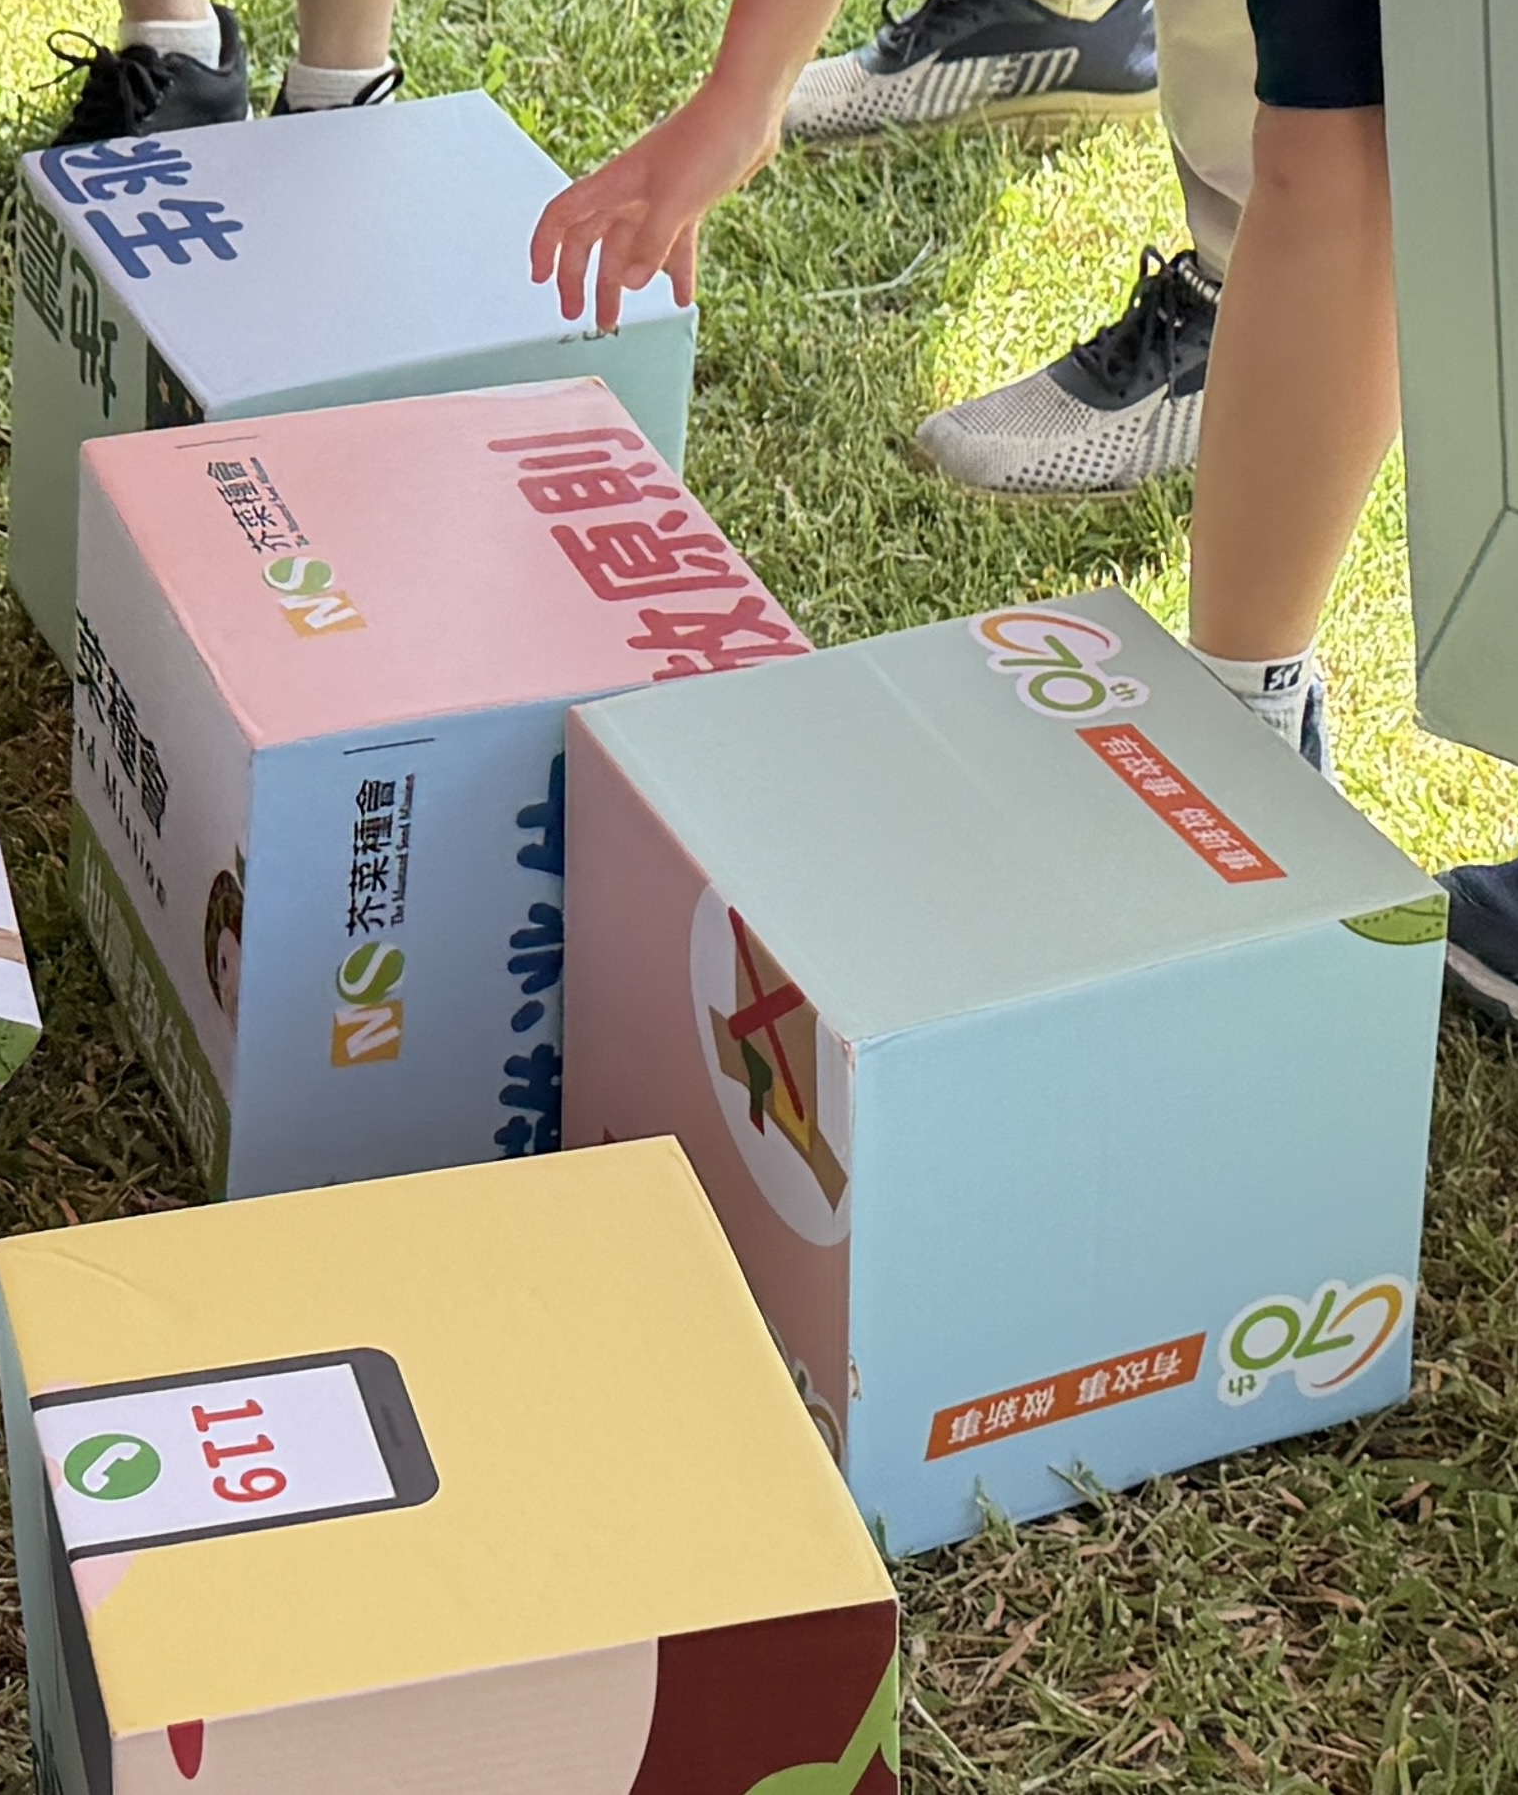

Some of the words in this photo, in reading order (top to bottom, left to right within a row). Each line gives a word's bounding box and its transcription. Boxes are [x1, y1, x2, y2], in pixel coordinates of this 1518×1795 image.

[347, 778, 396, 937] 芥菜種會
[190, 1397, 289, 1505] 119
